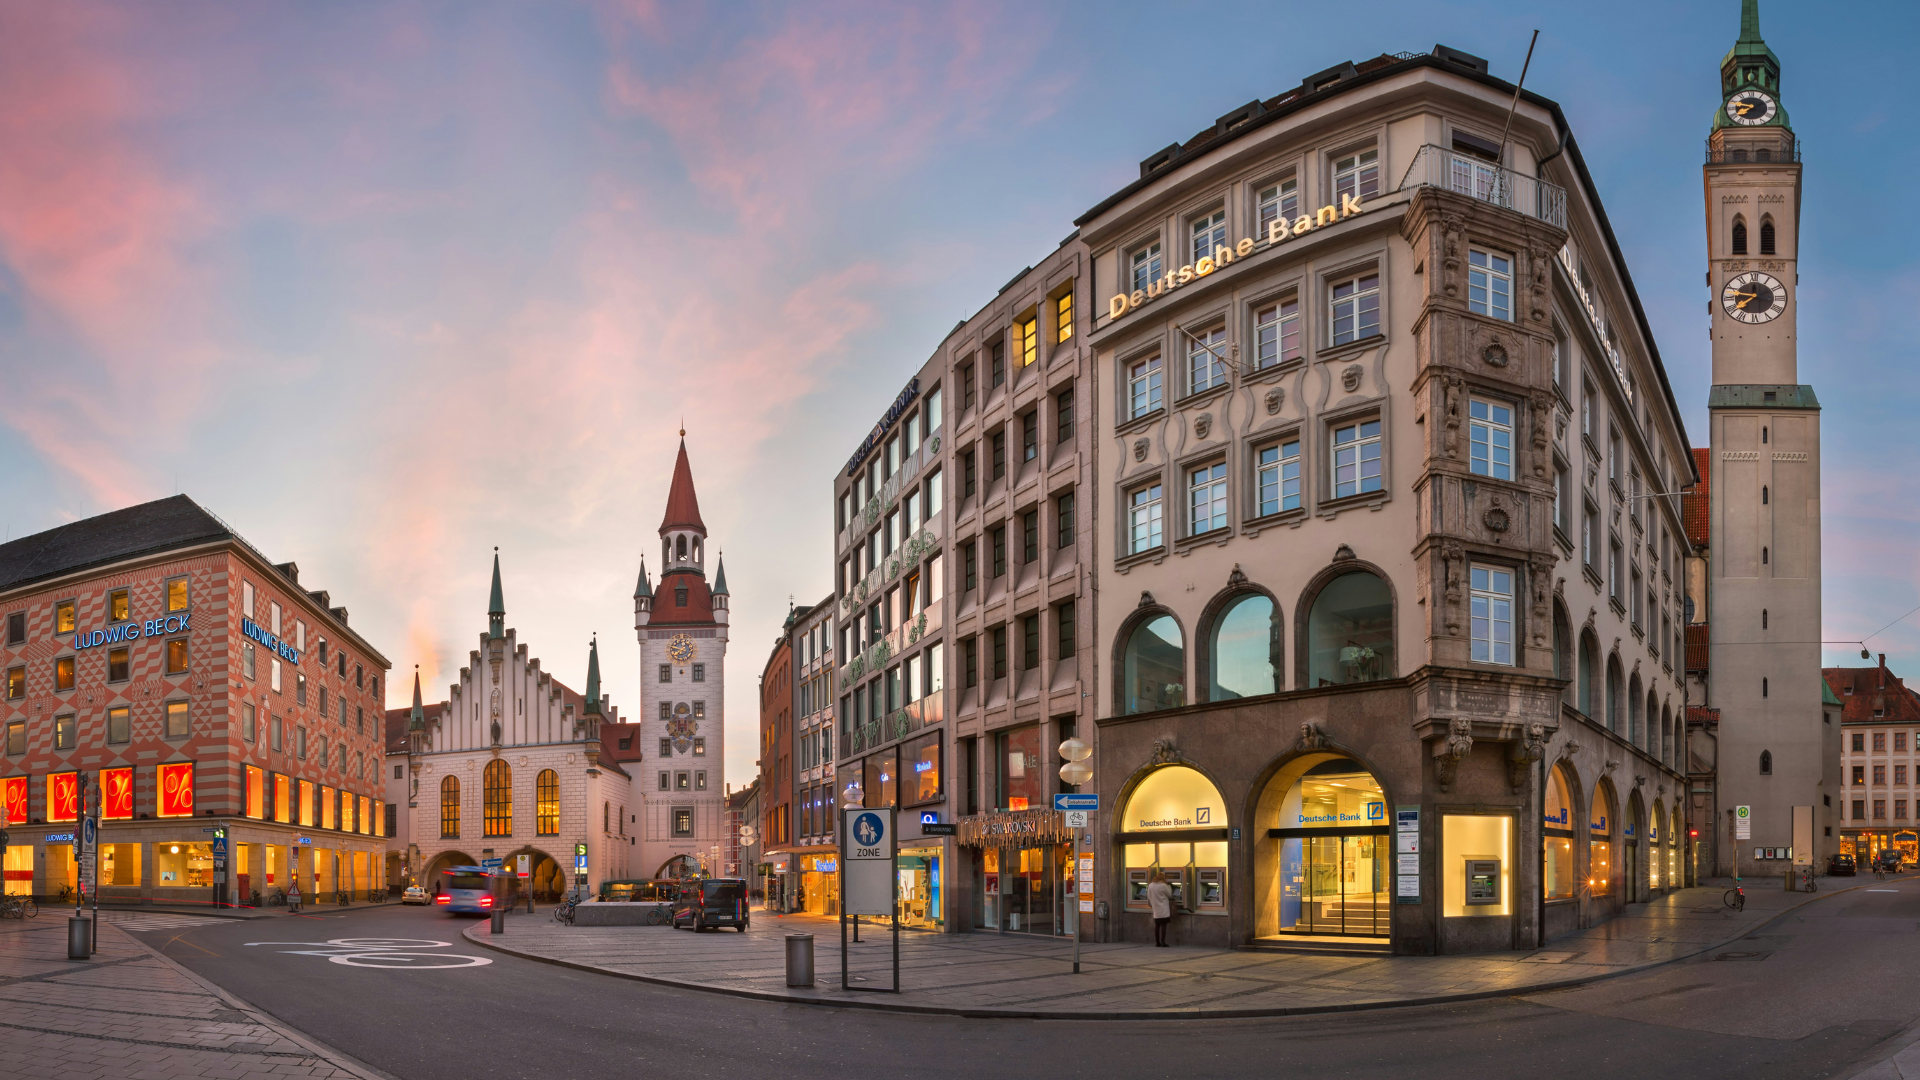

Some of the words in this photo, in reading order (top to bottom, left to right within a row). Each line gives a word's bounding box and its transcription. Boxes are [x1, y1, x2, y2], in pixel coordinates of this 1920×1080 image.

[1109, 237, 1256, 321] Deutsche
[1268, 193, 1364, 246] Bank
[1563, 244, 1612, 358] Deutsche
[1612, 349, 1633, 406] Bank
[847, 434, 875, 477] AUGEN
[885, 378, 920, 429] KLINIK
[74, 622, 141, 650] LUDWIG
[144, 613, 192, 638] BECK
[242, 617, 278, 652] LUDWIG
[279, 640, 300, 666] BECK
[1017, 754, 1037, 770] SALE
[1140, 819, 1172, 828] Deutsche
[1173, 818, 1192, 826] Bank
[1298, 814, 1338, 823] Deutsche
[1339, 812, 1361, 821] Bank
[991, 821, 1036, 835] SWAROVSKI
[45, 834, 67, 842] LUDWIG
[579, 844, 586, 856] S
[856, 848, 881, 857] ZONE
